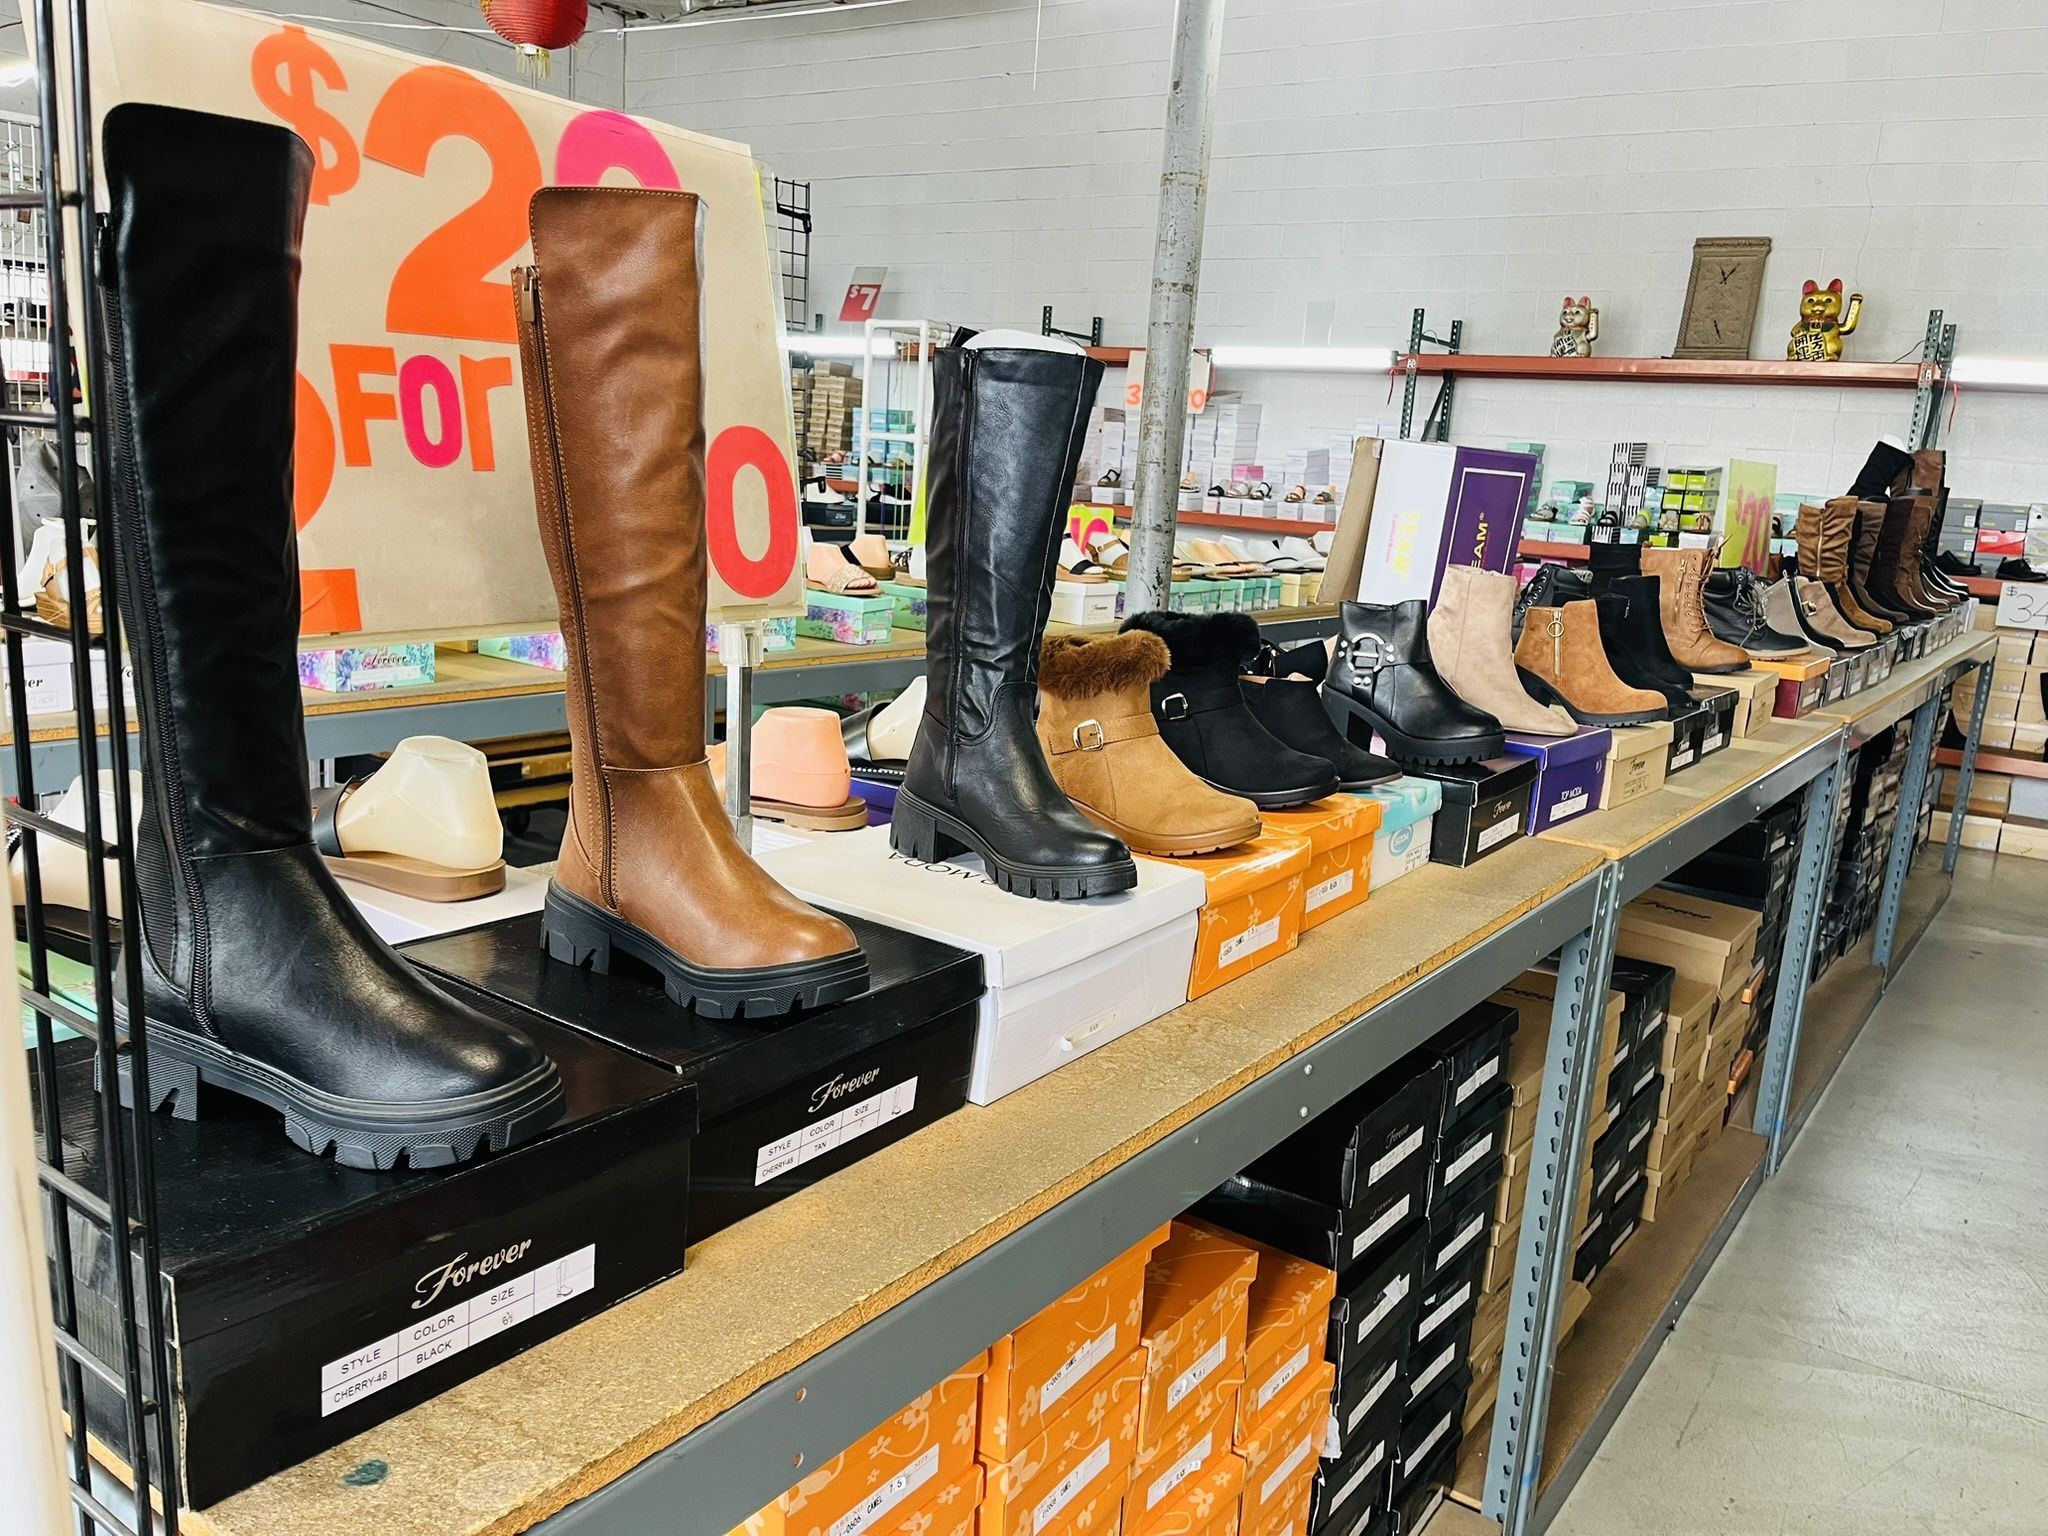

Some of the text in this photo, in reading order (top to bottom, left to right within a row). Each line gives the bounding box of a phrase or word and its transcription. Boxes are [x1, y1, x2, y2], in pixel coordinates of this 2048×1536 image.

[251, 25, 681, 344] $2
[849, 285, 877, 311] $7
[1190, 390, 1205, 409] 0
[707, 426, 798, 598] 0
[808, 1067, 880, 1113] Forever
[768, 1104, 869, 1156] STYLE COLOR SIZE
[814, 1141, 827, 1152] TAN
[410, 1238, 532, 1310] Forever
[341, 1287, 515, 1374] STYLE COLOR SIZE
[333, 1371, 388, 1403] CHERRY-48
[416, 1340, 452, 1364] BLACK
[867, 1495, 882, 1514] CAMEL
